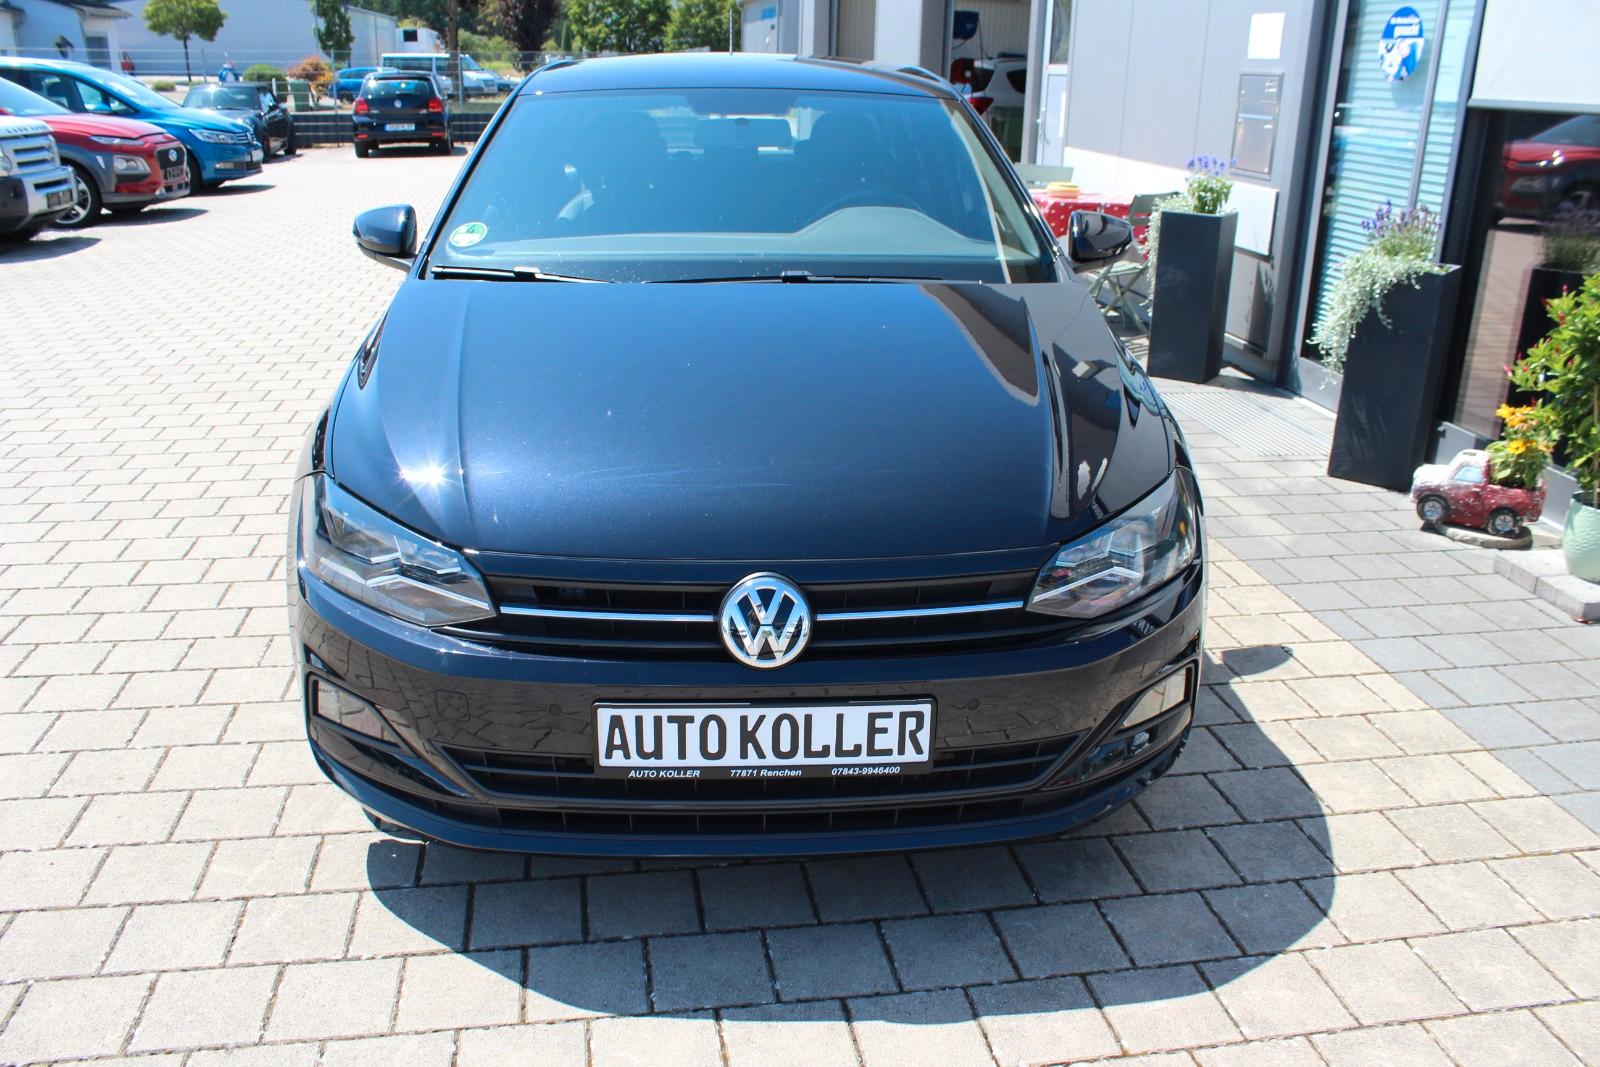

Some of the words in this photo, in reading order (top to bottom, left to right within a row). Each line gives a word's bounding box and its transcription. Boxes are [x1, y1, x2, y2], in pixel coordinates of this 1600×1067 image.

[604, 714, 727, 760] AUTO
[739, 711, 924, 760] KOLLER
[628, 770, 656, 779] AUTO
[659, 770, 700, 779] KOLLER
[730, 769, 757, 778] 77871
[760, 768, 802, 778] Renchen
[831, 766, 900, 776] 07843-9946400
